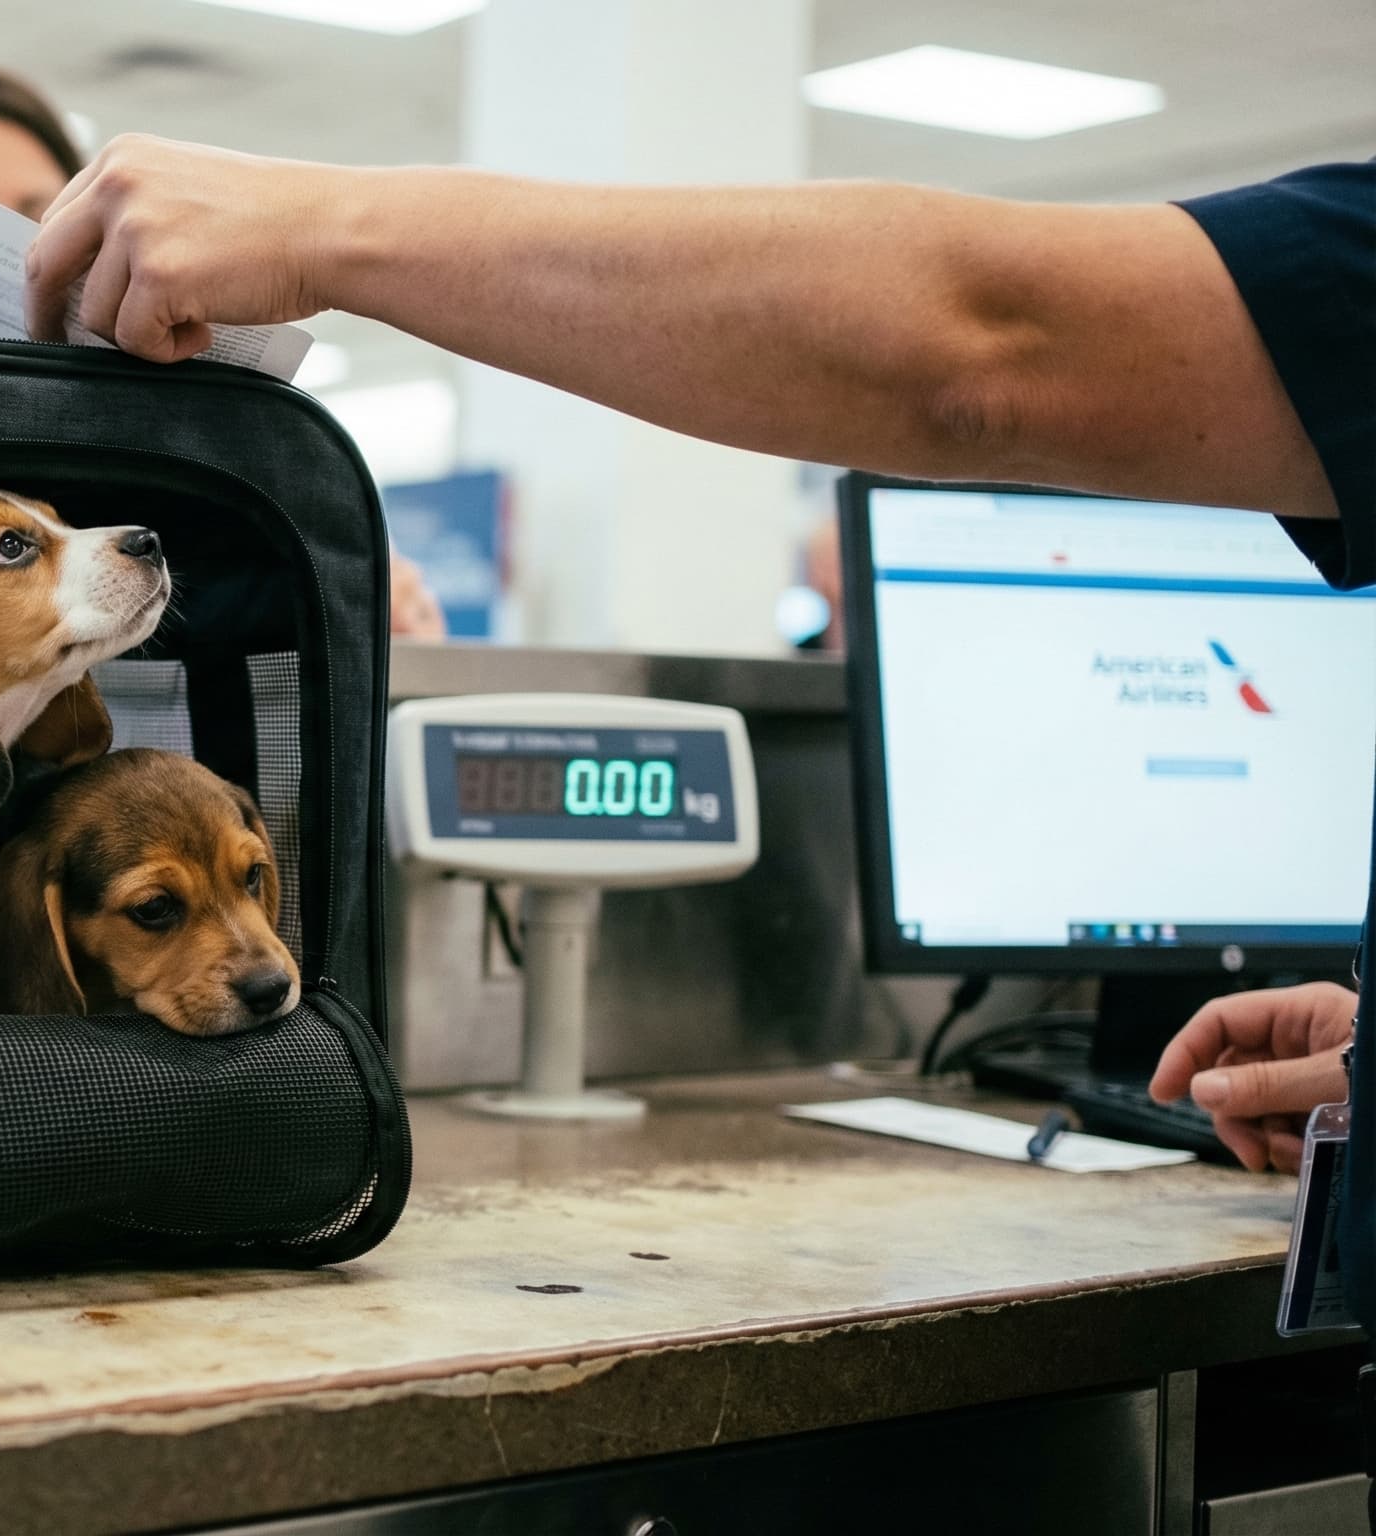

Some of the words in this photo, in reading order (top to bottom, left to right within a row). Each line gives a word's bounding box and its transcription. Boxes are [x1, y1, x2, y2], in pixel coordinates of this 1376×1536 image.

[1092, 652, 1208, 677] American
[1119, 682, 1208, 706] Airlines
[564, 759, 674, 817] 0.00
[684, 787, 720, 823] kg
